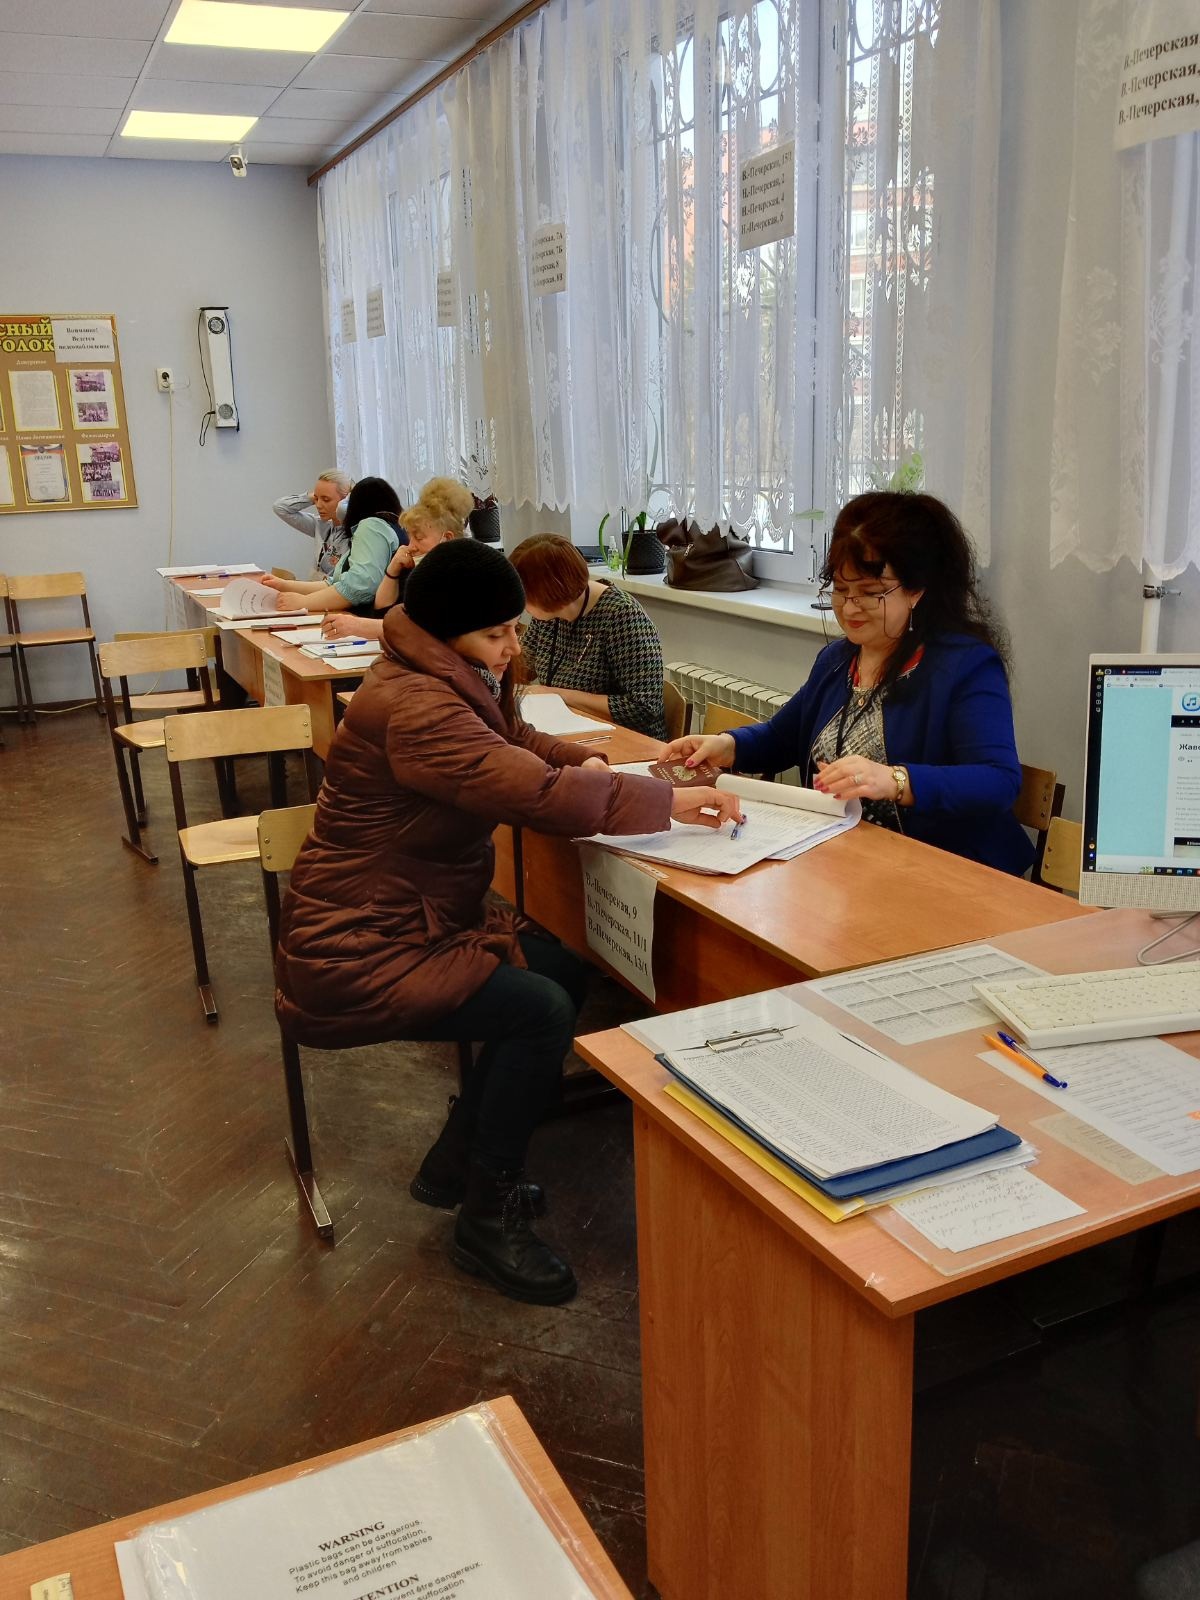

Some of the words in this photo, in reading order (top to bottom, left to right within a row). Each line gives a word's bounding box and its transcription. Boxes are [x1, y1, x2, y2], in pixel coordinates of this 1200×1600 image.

[0, 338, 54, 352] ОЛОК
[632, 906, 637, 920] 9
[289, 1559, 320, 1574] Plastic
[321, 1551, 343, 1563] bags
[345, 1543, 361, 1553] can
[362, 1538, 373, 1547] be
[375, 1520, 423, 1542] dangerous.
[318, 1521, 385, 1552] WARNING
[293, 1575, 306, 1583] To
[307, 1564, 332, 1579] avoid
[333, 1552, 364, 1568] danger
[366, 1547, 374, 1556] of
[376, 1529, 426, 1551] suffocation.
[295, 1580, 320, 1593] Keep
[321, 1572, 338, 1583] this
[339, 1565, 357, 1577] bag
[358, 1556, 381, 1569] away
[382, 1547, 403, 1559] from
[403, 1535, 433, 1551] babies
[343, 1574, 360, 1586] and
[361, 1560, 397, 1578] children
